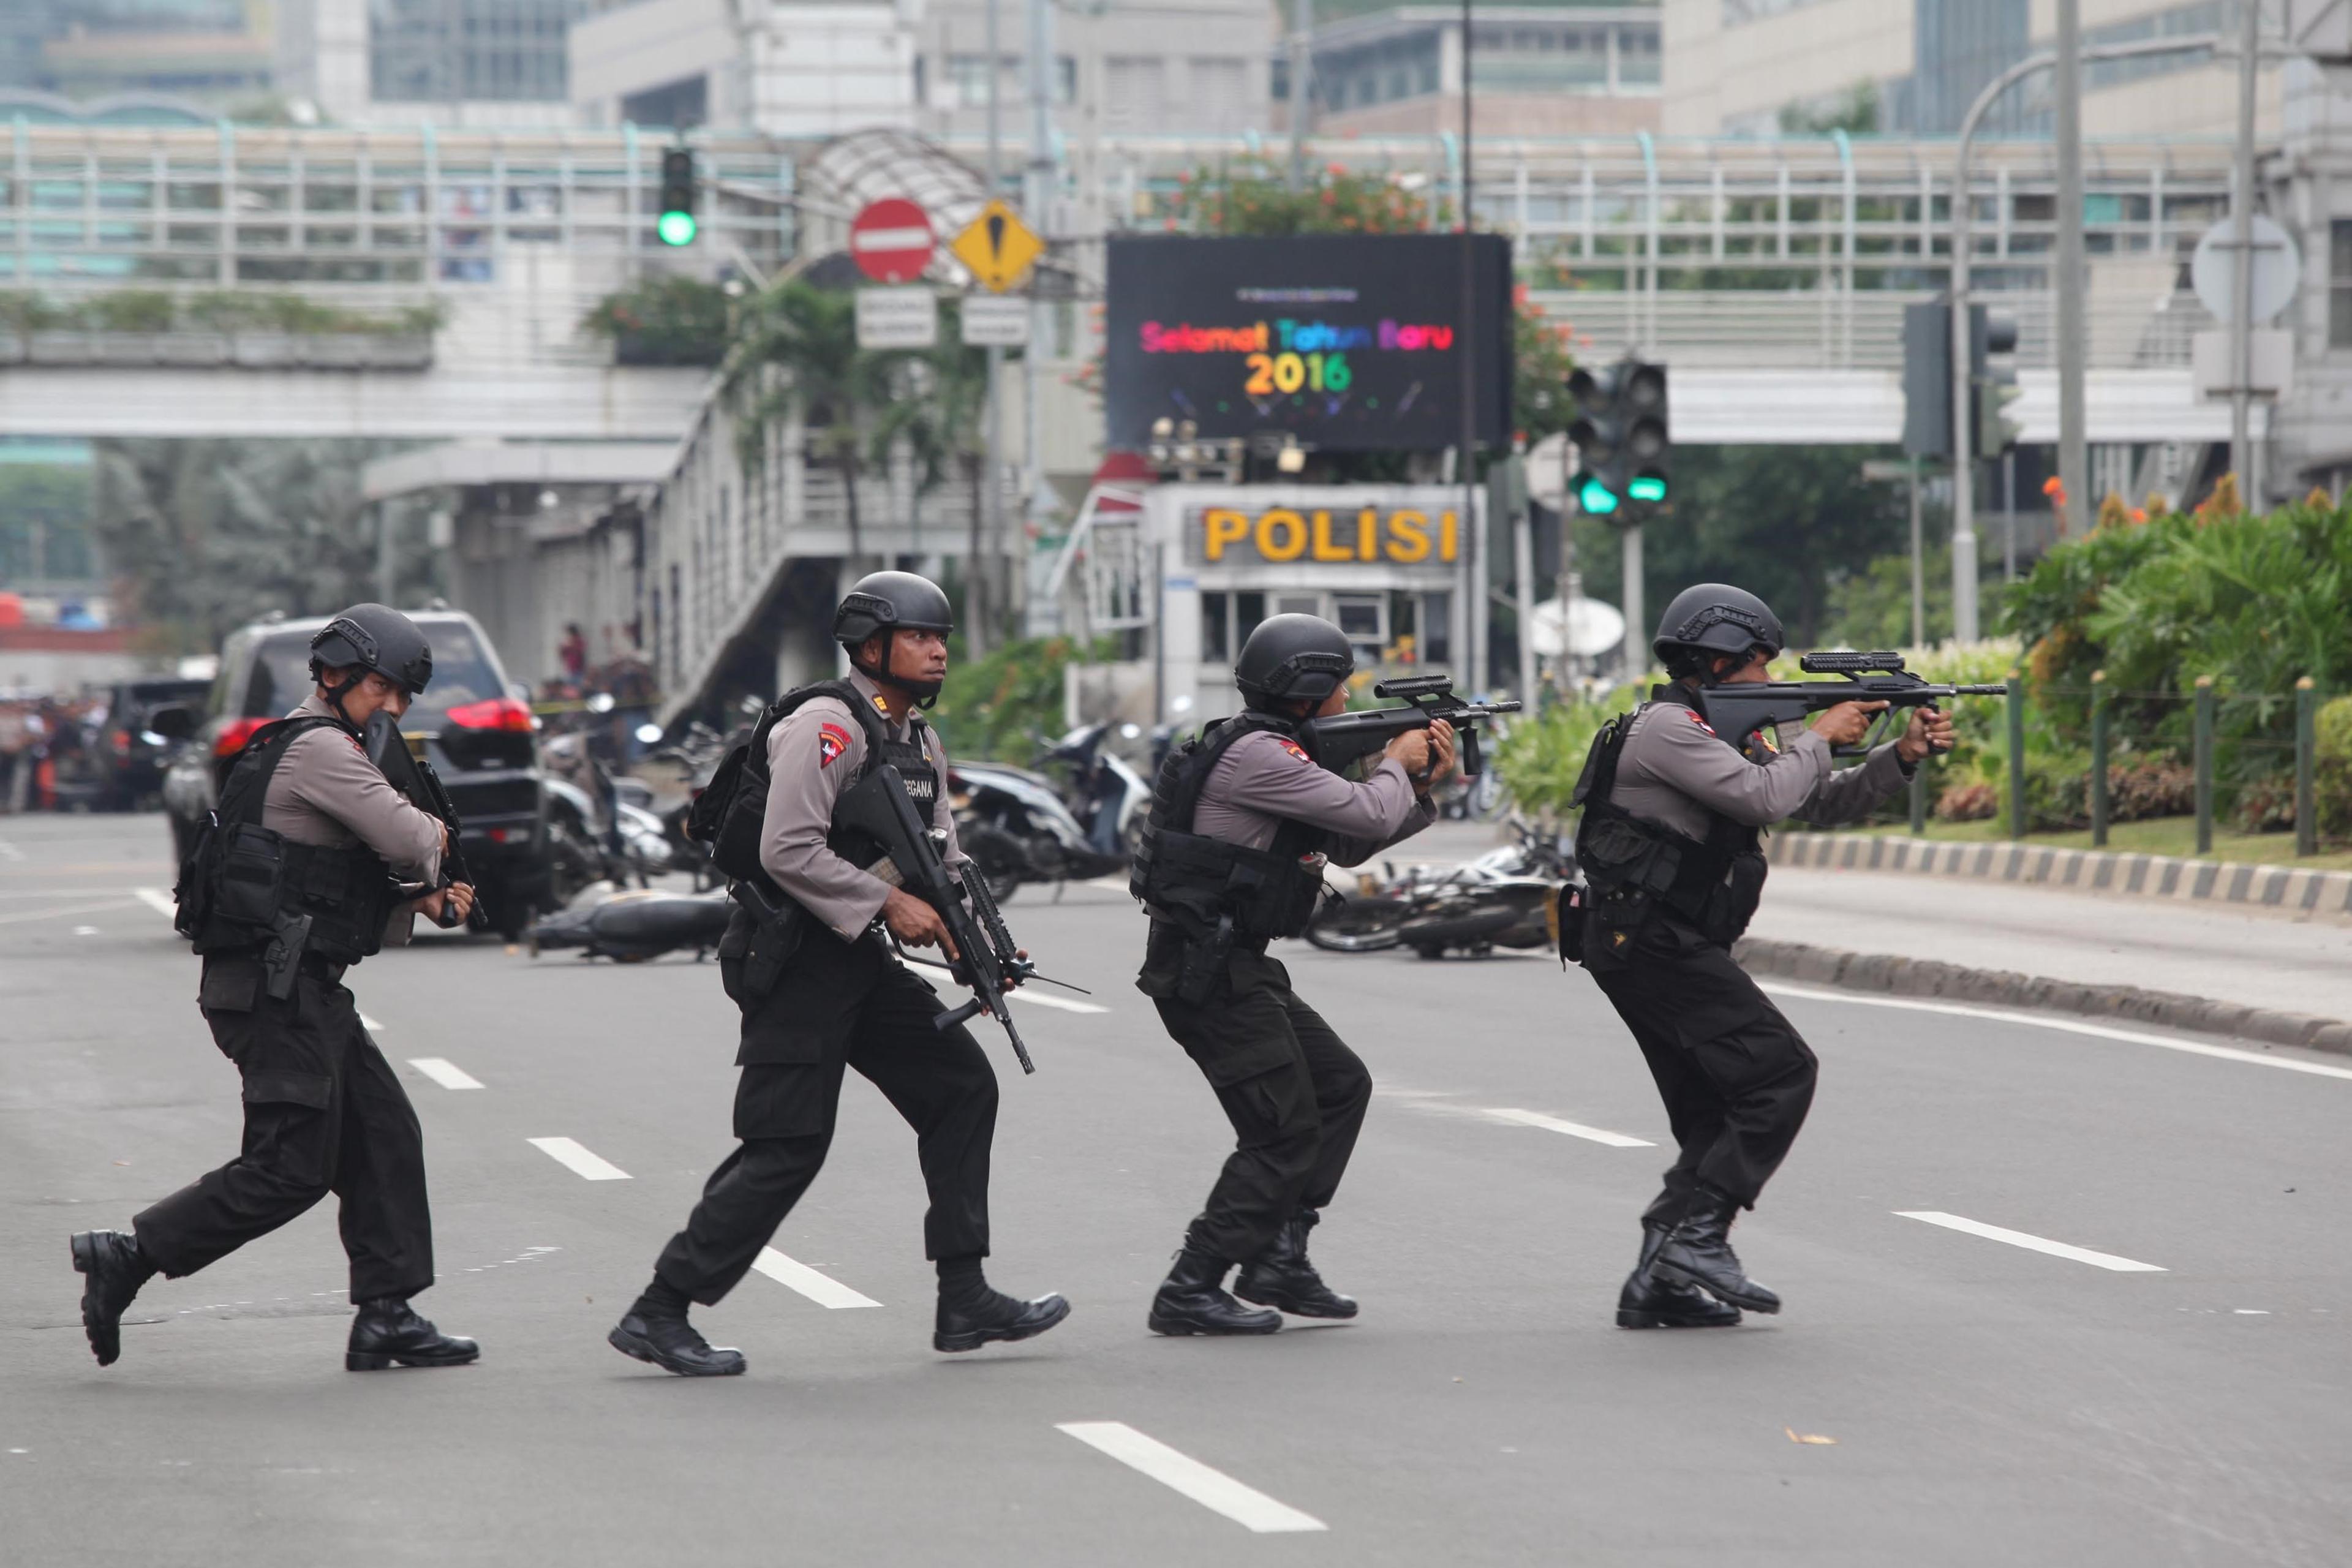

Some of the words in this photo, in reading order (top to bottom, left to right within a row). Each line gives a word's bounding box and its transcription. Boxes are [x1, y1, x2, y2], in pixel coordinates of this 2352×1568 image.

[1141, 320, 1268, 352] Selamat
[1276, 318, 1372, 351] Tahun
[1378, 318, 1453, 350] Baru
[1244, 352, 1352, 394] 2016
[1206, 508, 1458, 562] POLISI
